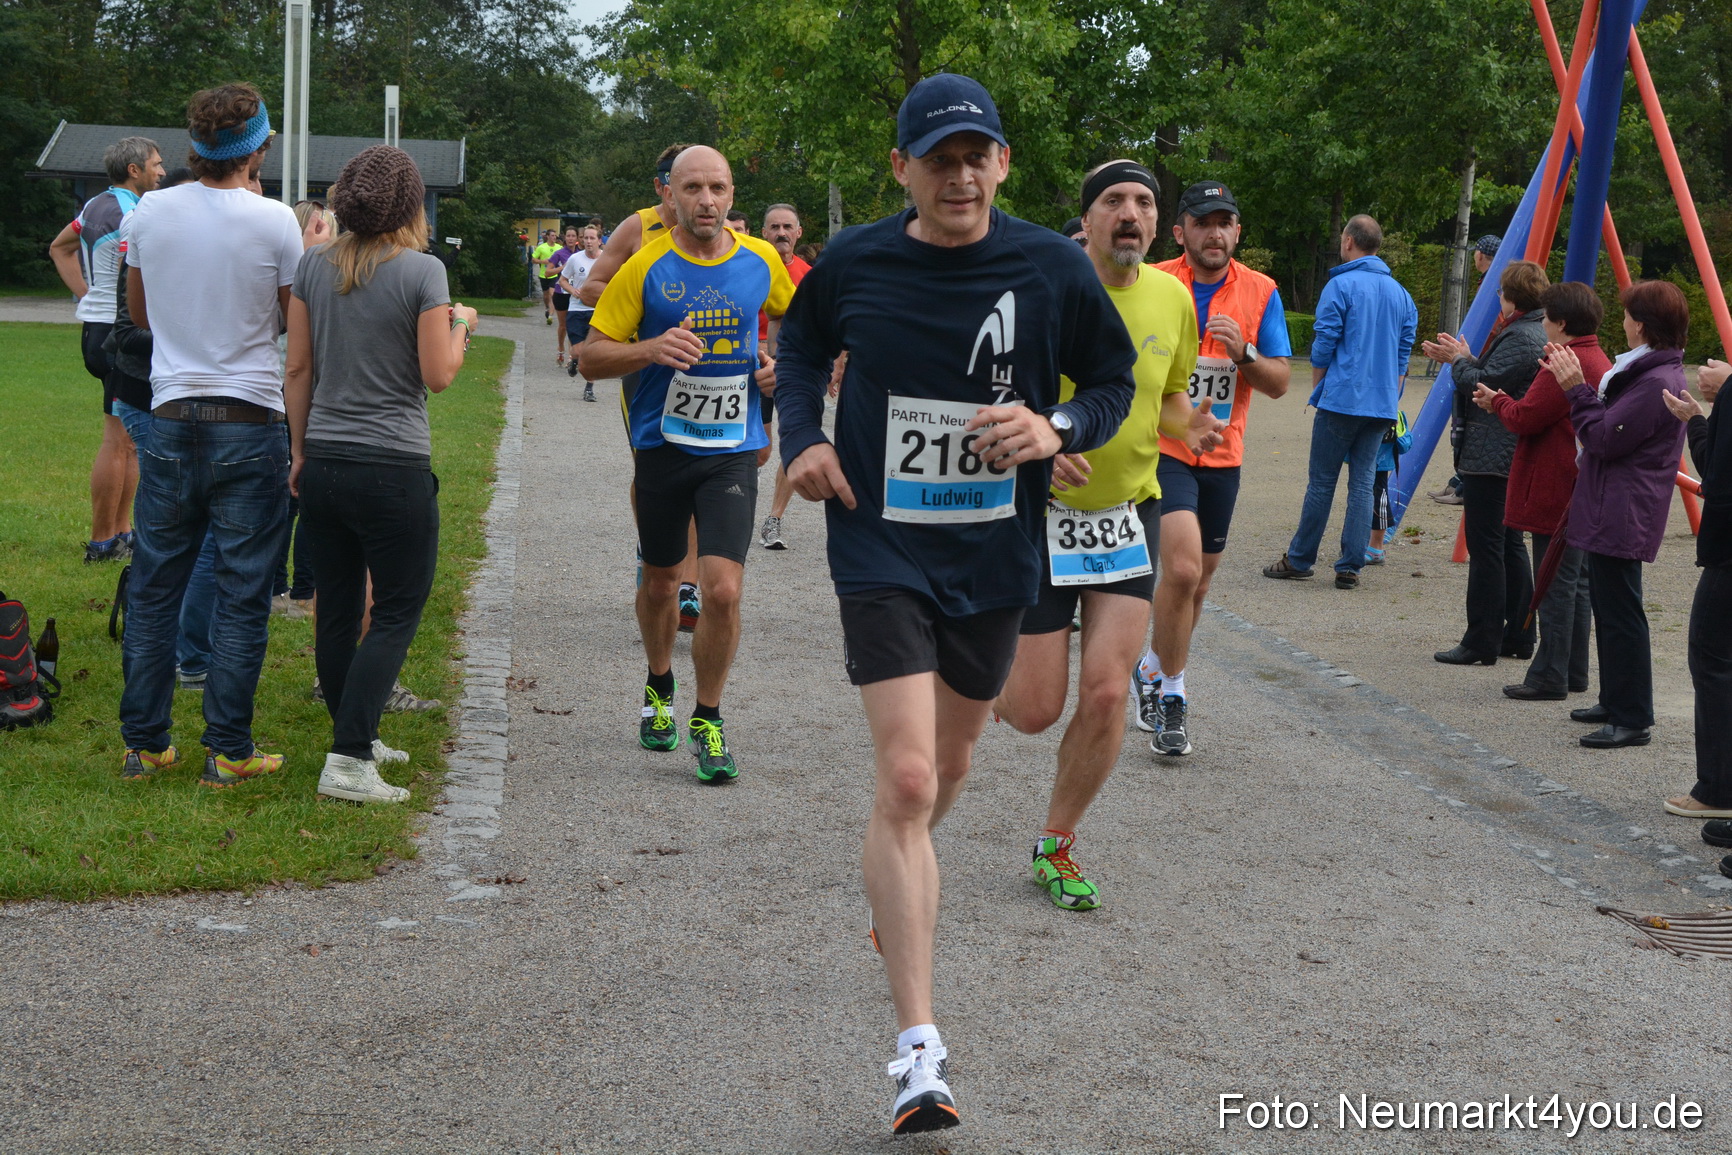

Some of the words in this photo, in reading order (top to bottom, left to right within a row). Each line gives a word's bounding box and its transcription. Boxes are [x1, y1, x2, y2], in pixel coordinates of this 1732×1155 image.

[926, 105, 968, 118] RAIL.ONE
[672, 377, 698, 391] PARTL
[700, 383, 737, 392] Neumarkt
[673, 391, 741, 421] 2713
[891, 408, 936, 424] PARTL
[683, 423, 724, 438] Thomas
[921, 487, 984, 509] Ludwig
[1058, 515, 1137, 550] 3384
